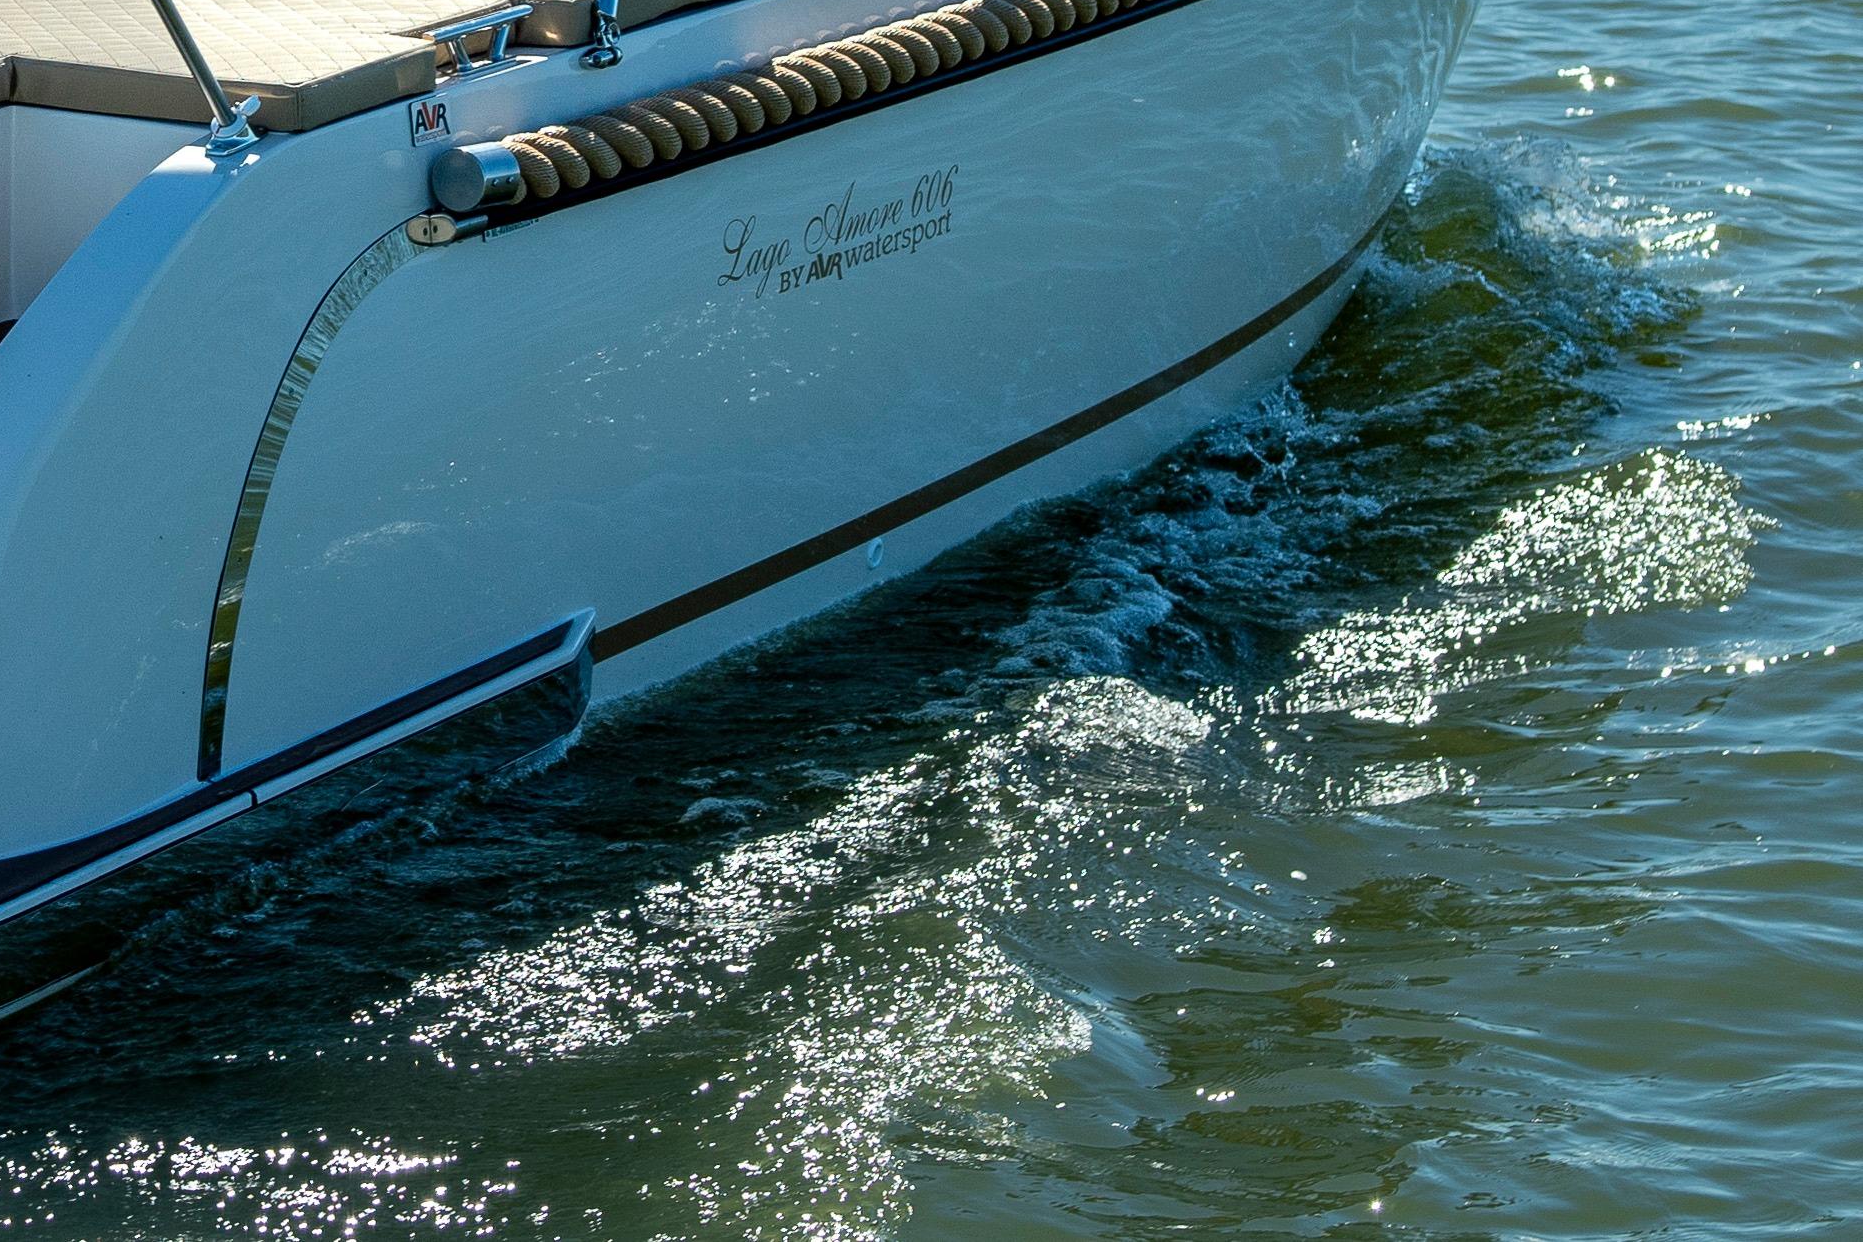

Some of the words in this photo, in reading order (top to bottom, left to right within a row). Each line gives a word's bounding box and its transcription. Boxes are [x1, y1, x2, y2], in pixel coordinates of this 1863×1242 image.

[415, 101, 451, 135] AVR
[717, 215, 792, 299] Lago
[804, 181, 904, 253] Amore
[911, 164, 959, 218] 606
[778, 264, 806, 294] BY
[806, 251, 843, 285] AVR
[843, 208, 952, 267] watersport
